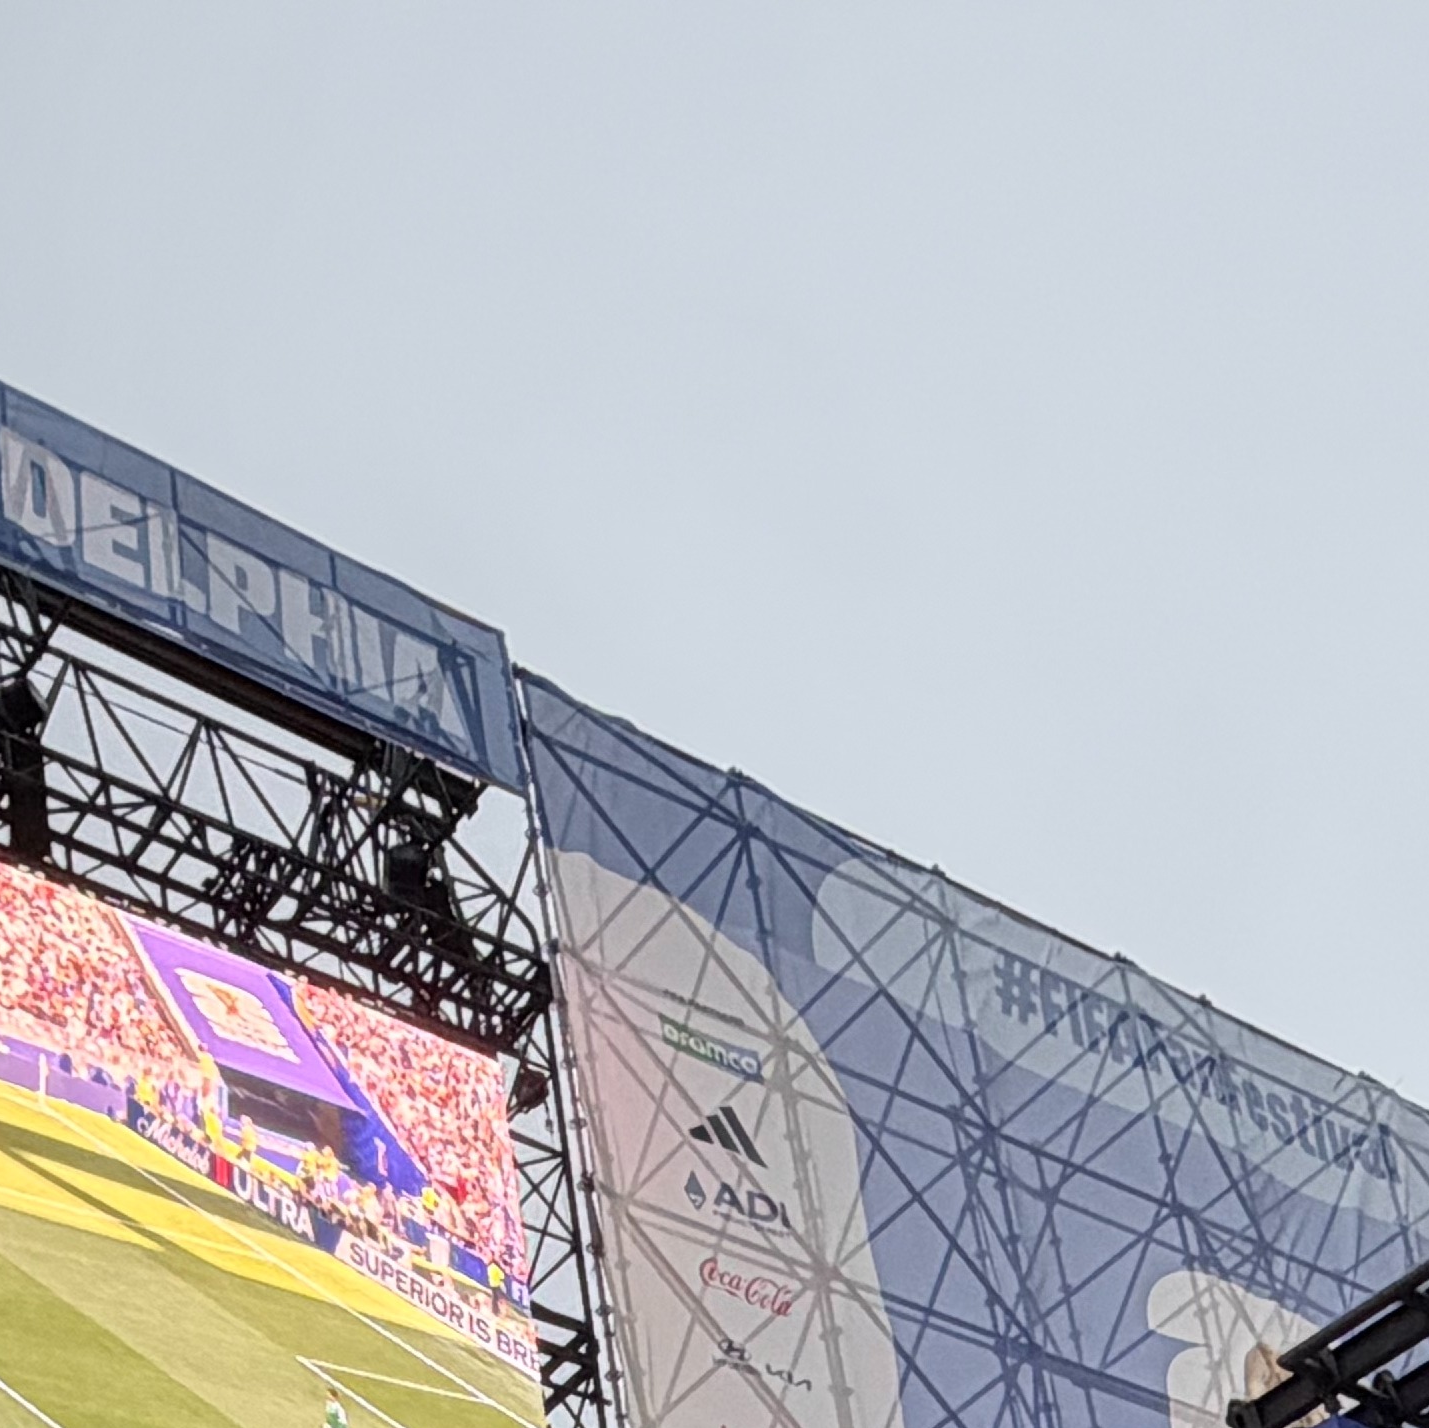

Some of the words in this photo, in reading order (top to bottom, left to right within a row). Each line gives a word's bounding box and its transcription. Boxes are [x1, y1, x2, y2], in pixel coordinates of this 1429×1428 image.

[663, 1022, 758, 1075] aramco
[232, 1169, 316, 1243] ULTRA
[349, 1241, 465, 1330] SUPERIOR
[468, 1312, 492, 1344] IS
